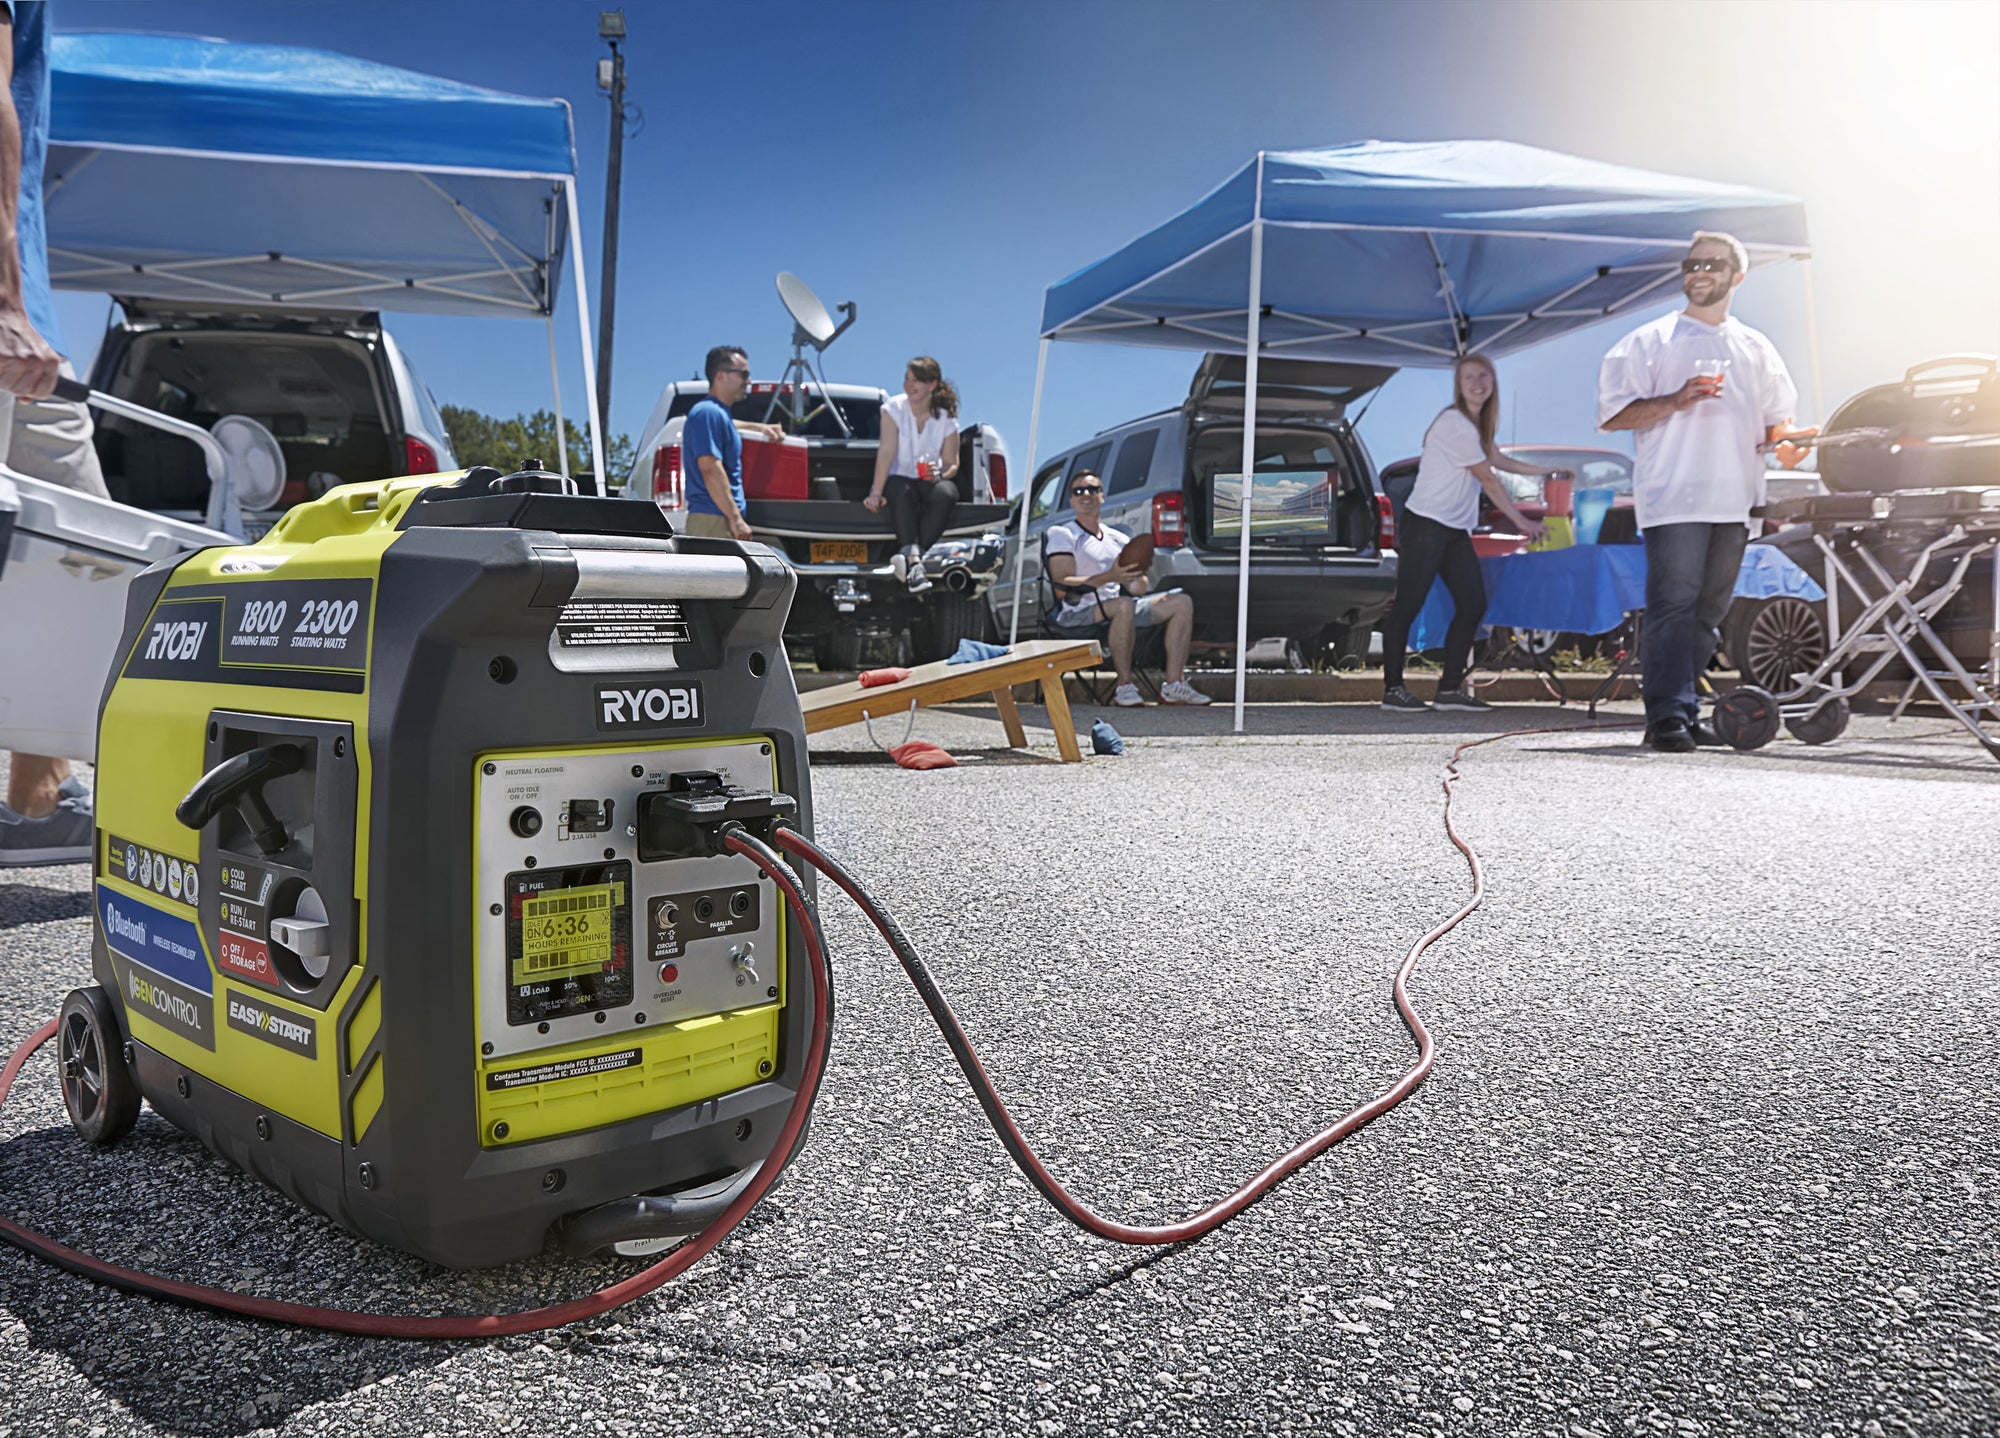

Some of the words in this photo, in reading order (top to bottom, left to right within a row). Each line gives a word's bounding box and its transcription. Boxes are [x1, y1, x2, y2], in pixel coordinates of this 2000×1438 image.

[239, 601, 287, 633] 1800
[294, 600, 358, 635] 2300
[145, 621, 208, 660] RYOBI
[231, 635, 259, 647] RUNNING
[259, 636, 279, 648] WATTS
[290, 636, 322, 649] STARTING
[323, 638, 347, 650] WATTS
[600, 688, 698, 723] RYOBI
[505, 768, 532, 776] NEUTRAL
[230, 868, 245, 880] COLD
[230, 879, 246, 892] START
[230, 903, 242, 916] RUN
[115, 910, 146, 947] Bluetooth
[230, 914, 256, 931] RE-START
[527, 920, 541, 928] IDLE
[543, 914, 589, 939] 6:36
[710, 920, 733, 928] PARALLEL
[527, 929, 541, 939] ON
[153, 935, 171, 951] WIRELESS
[171, 942, 197, 960] TECHNOLOGY
[230, 943, 241, 955] OFF
[528, 939, 558, 950] HOURS
[561, 935, 607, 946] REMAINING
[656, 941, 677, 950] CIRCUIT
[655, 947, 678, 956] BREAKER
[230, 955, 256, 971] STORAGE
[604, 975, 620, 983] 100%
[532, 986, 550, 995] LOAD
[564, 982, 578, 990] 50%
[653, 989, 682, 1000] OVERLOAD
[134, 977, 202, 1030] GENCONTROL
[229, 1000, 263, 1027] EASY
[269, 1015, 312, 1045] START
[494, 1072, 520, 1081] Contains
[521, 1066, 553, 1077] Transmitter
[554, 1062, 575, 1071] Module
[576, 1059, 587, 1067] FCC
[504, 1077, 538, 1087] Transmitter
[539, 1072, 559, 1081] Module
